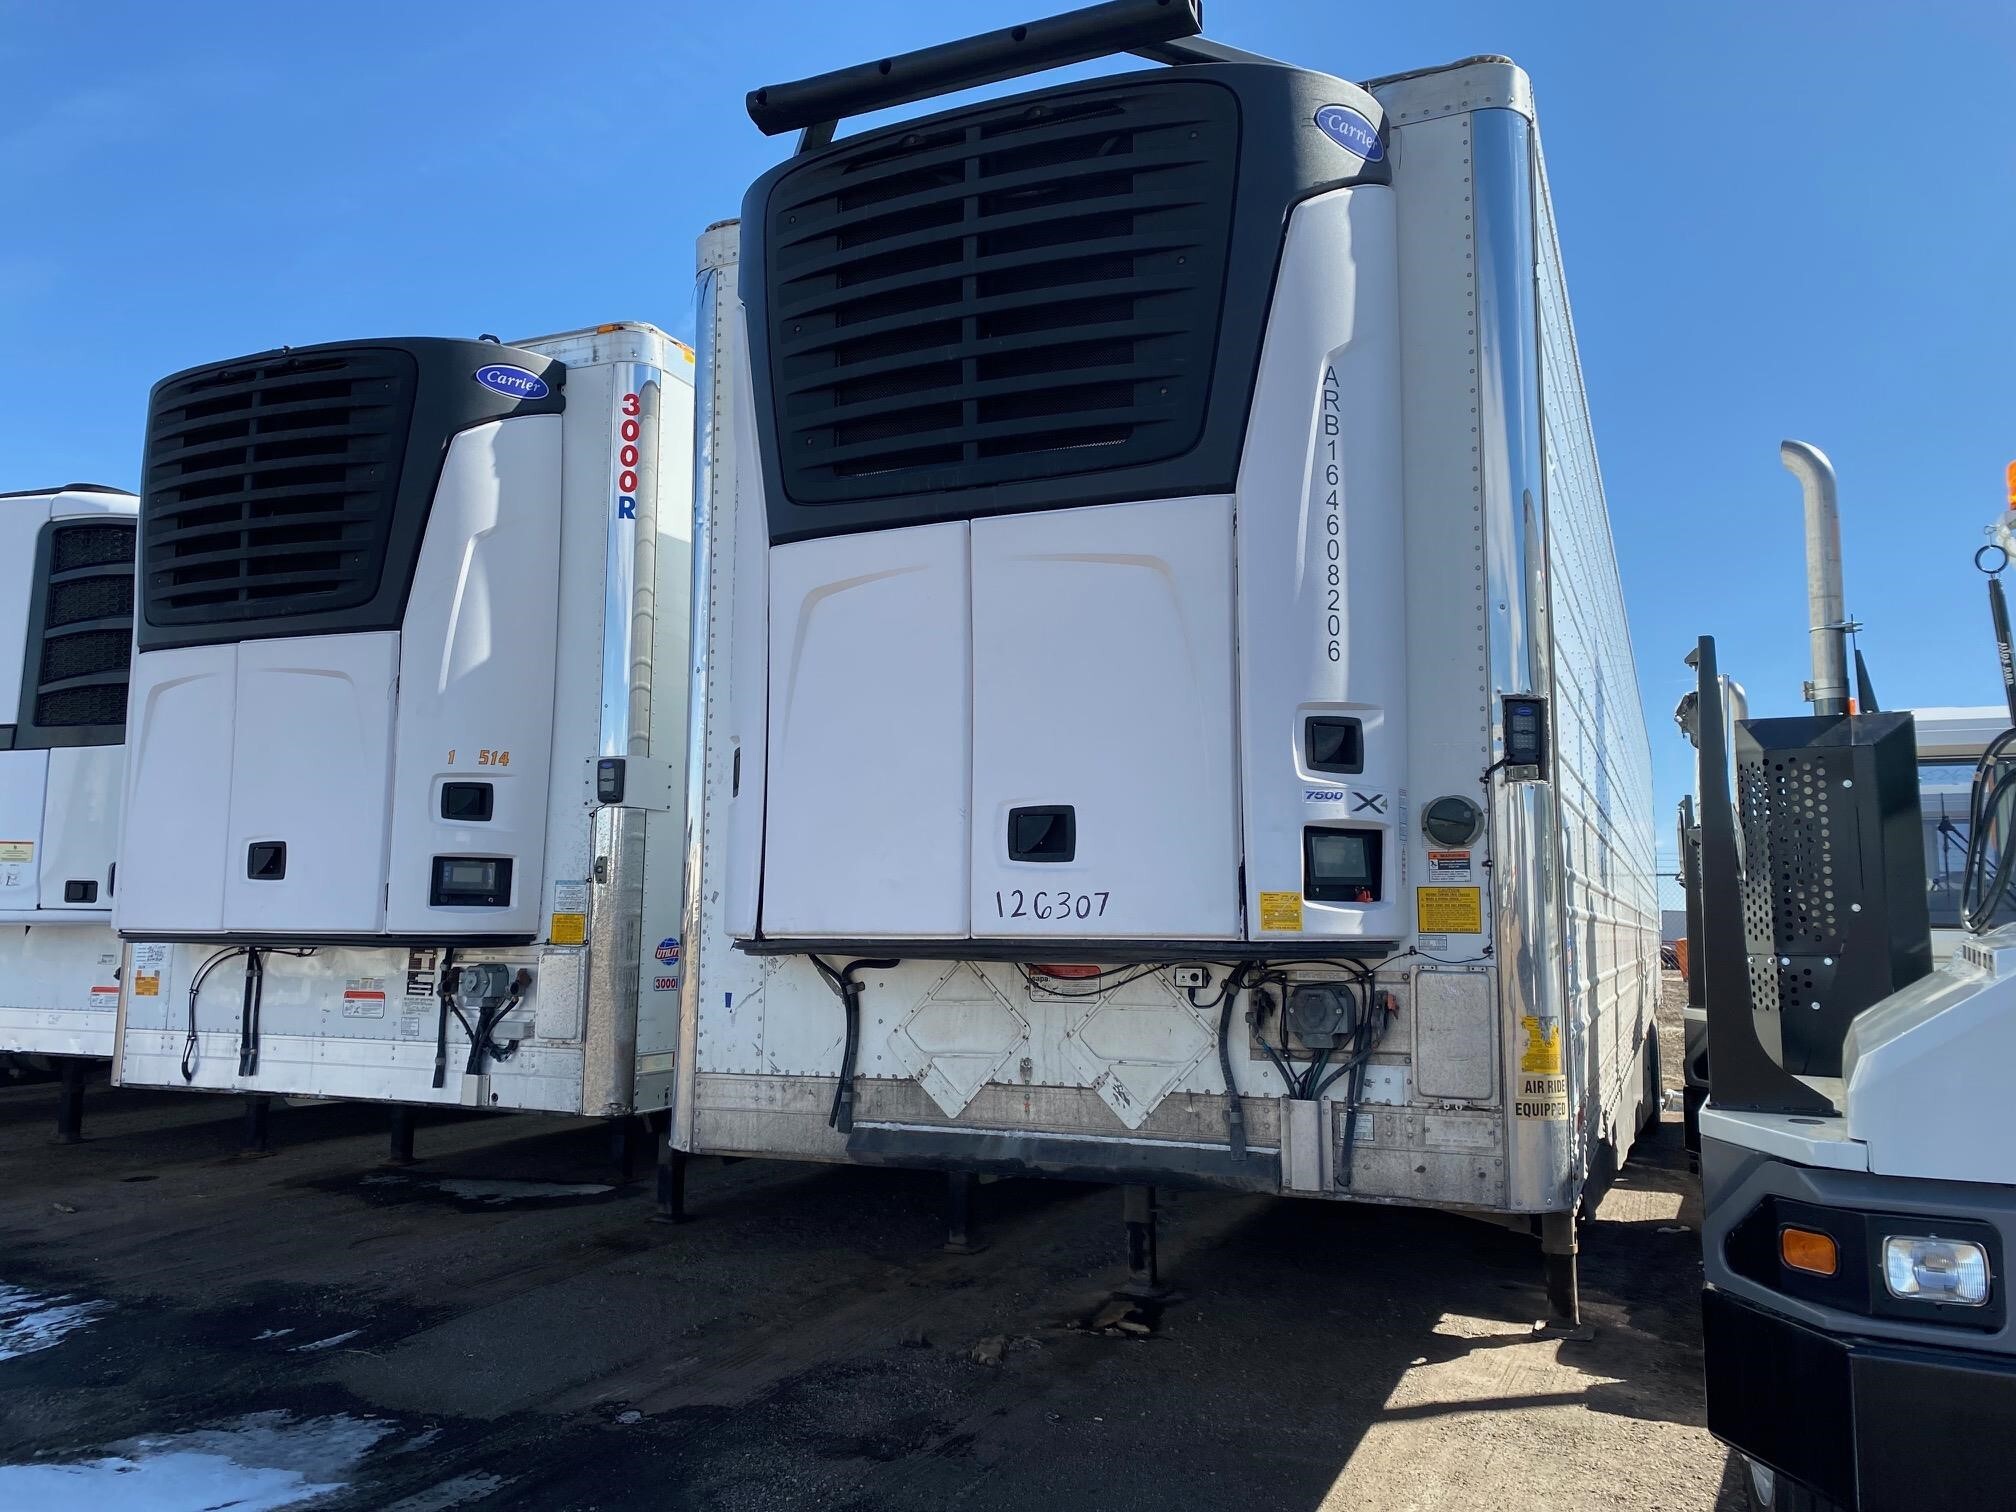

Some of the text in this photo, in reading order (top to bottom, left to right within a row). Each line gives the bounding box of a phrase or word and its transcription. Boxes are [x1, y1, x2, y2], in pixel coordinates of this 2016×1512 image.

[1328, 114, 1378, 151] Carrier
[486, 370, 541, 392] Carrier
[618, 393, 641, 520] 3000R
[1322, 365, 1341, 662] ARB164608206
[478, 749, 510, 767] 514
[1305, 790, 1344, 801] 7500
[996, 889, 1110, 920] 126307
[1525, 1079, 1565, 1094] AIR RIDE
[1515, 1102, 1566, 1118] EQUIPPED
